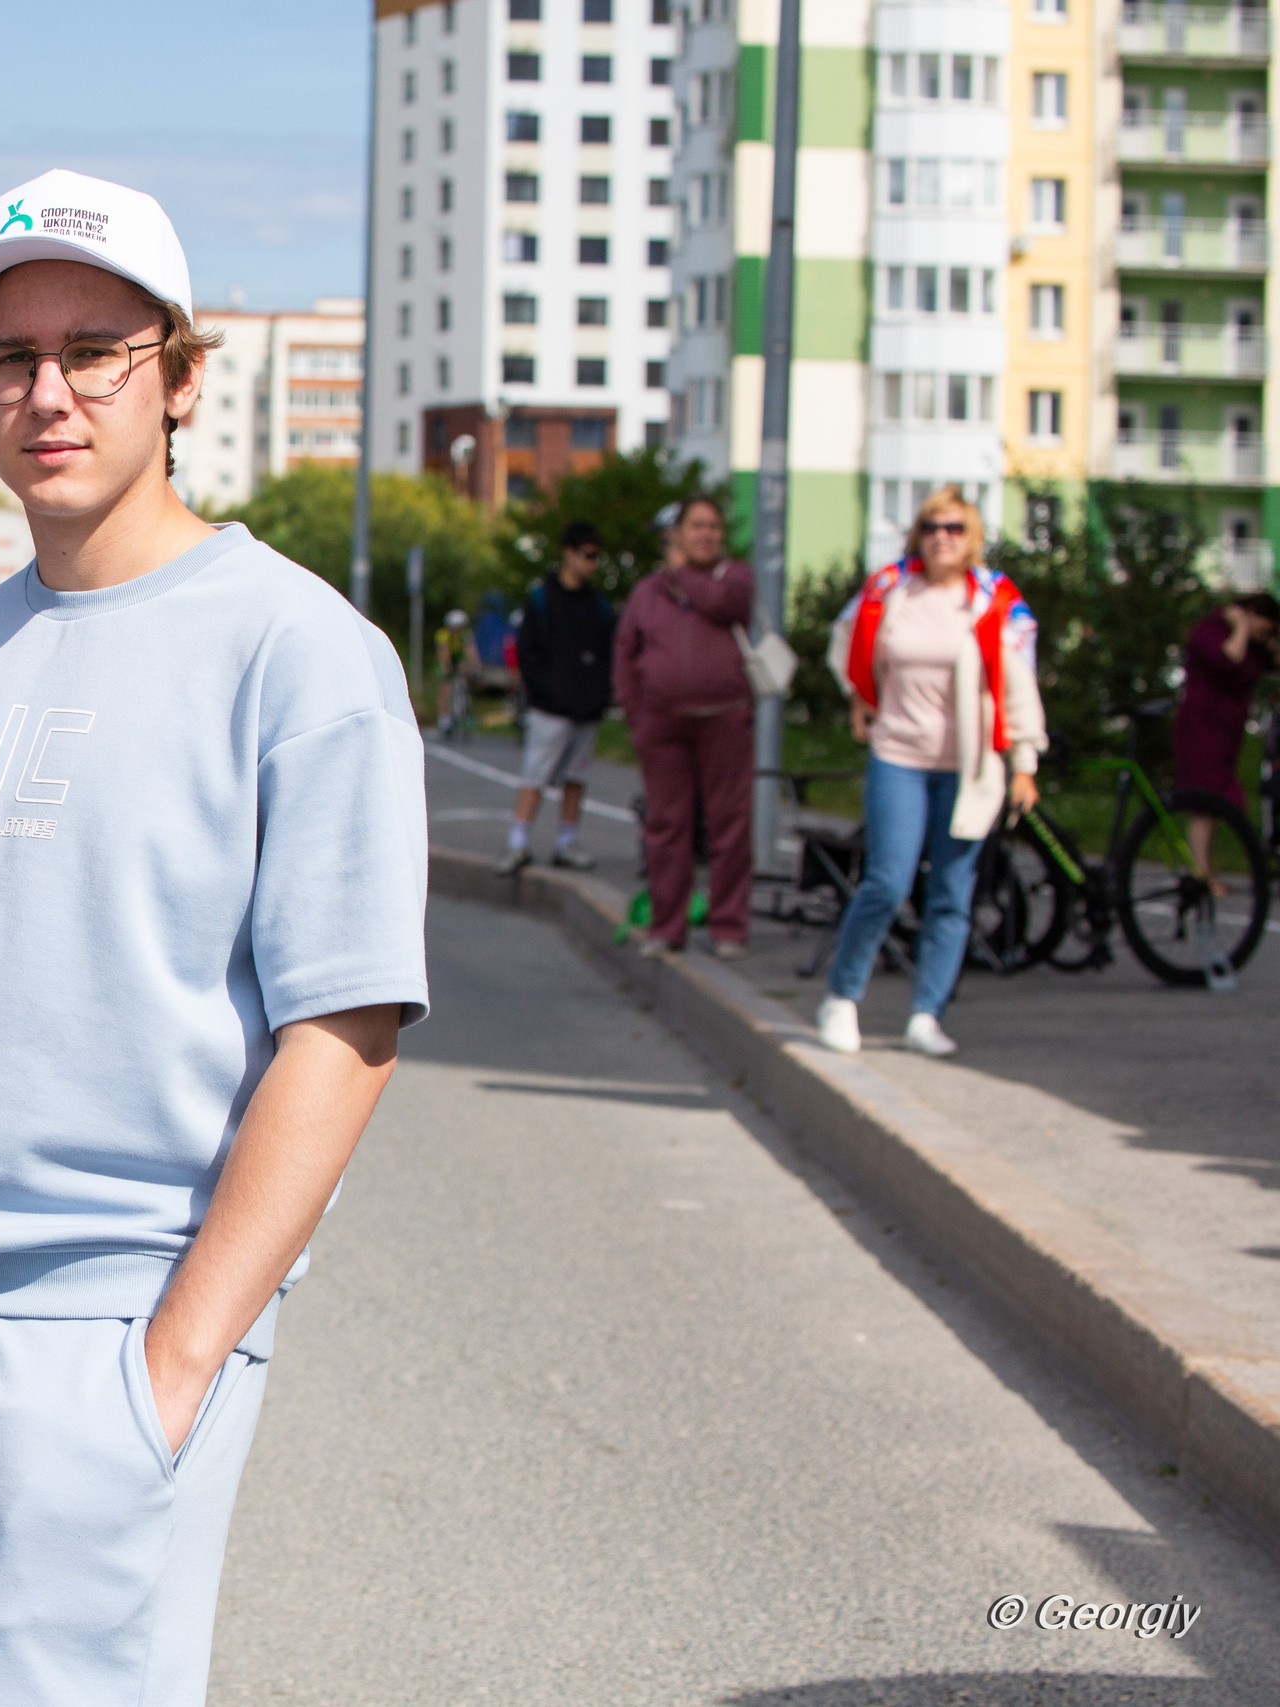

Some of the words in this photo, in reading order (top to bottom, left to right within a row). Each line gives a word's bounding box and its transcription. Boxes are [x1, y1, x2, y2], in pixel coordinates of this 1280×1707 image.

[40, 207, 109, 225] СПОРТИВНАЯ
[43, 218, 83, 230] ШКОЛА
[85, 221, 104, 235] №2
